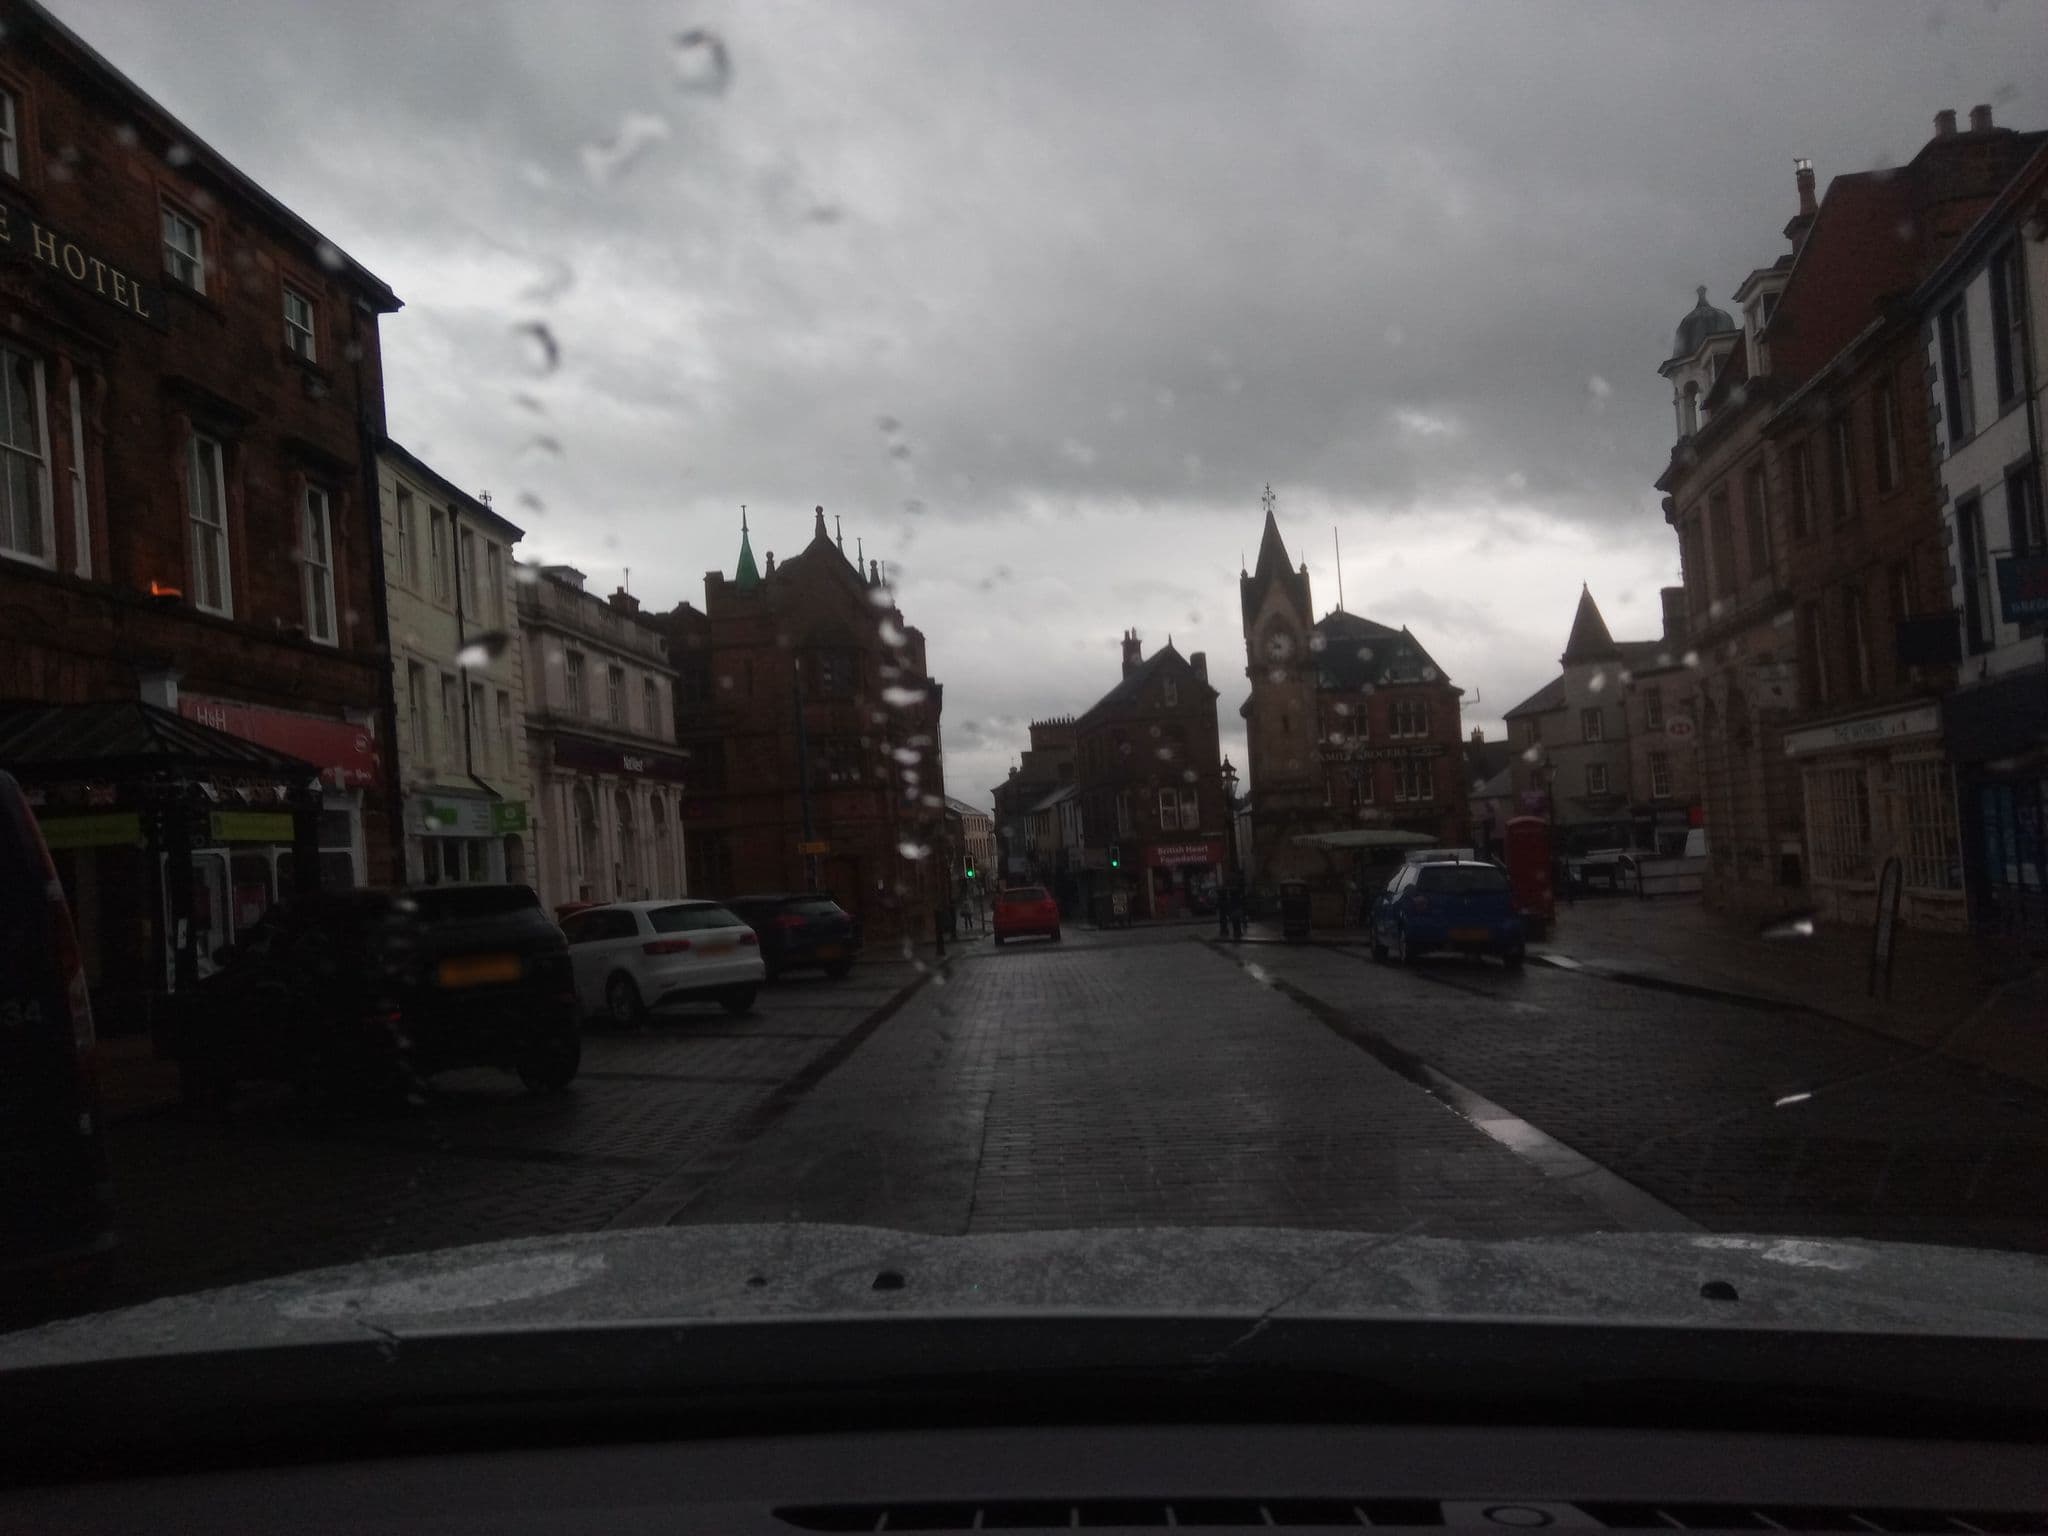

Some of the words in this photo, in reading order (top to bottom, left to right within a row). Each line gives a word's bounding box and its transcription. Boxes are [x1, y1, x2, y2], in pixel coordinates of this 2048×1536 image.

[32, 222, 150, 319] HOTEL
[1157, 846, 1185, 856] British
[1186, 844, 1208, 853] Heart
[1160, 855, 1207, 864] Foundation
